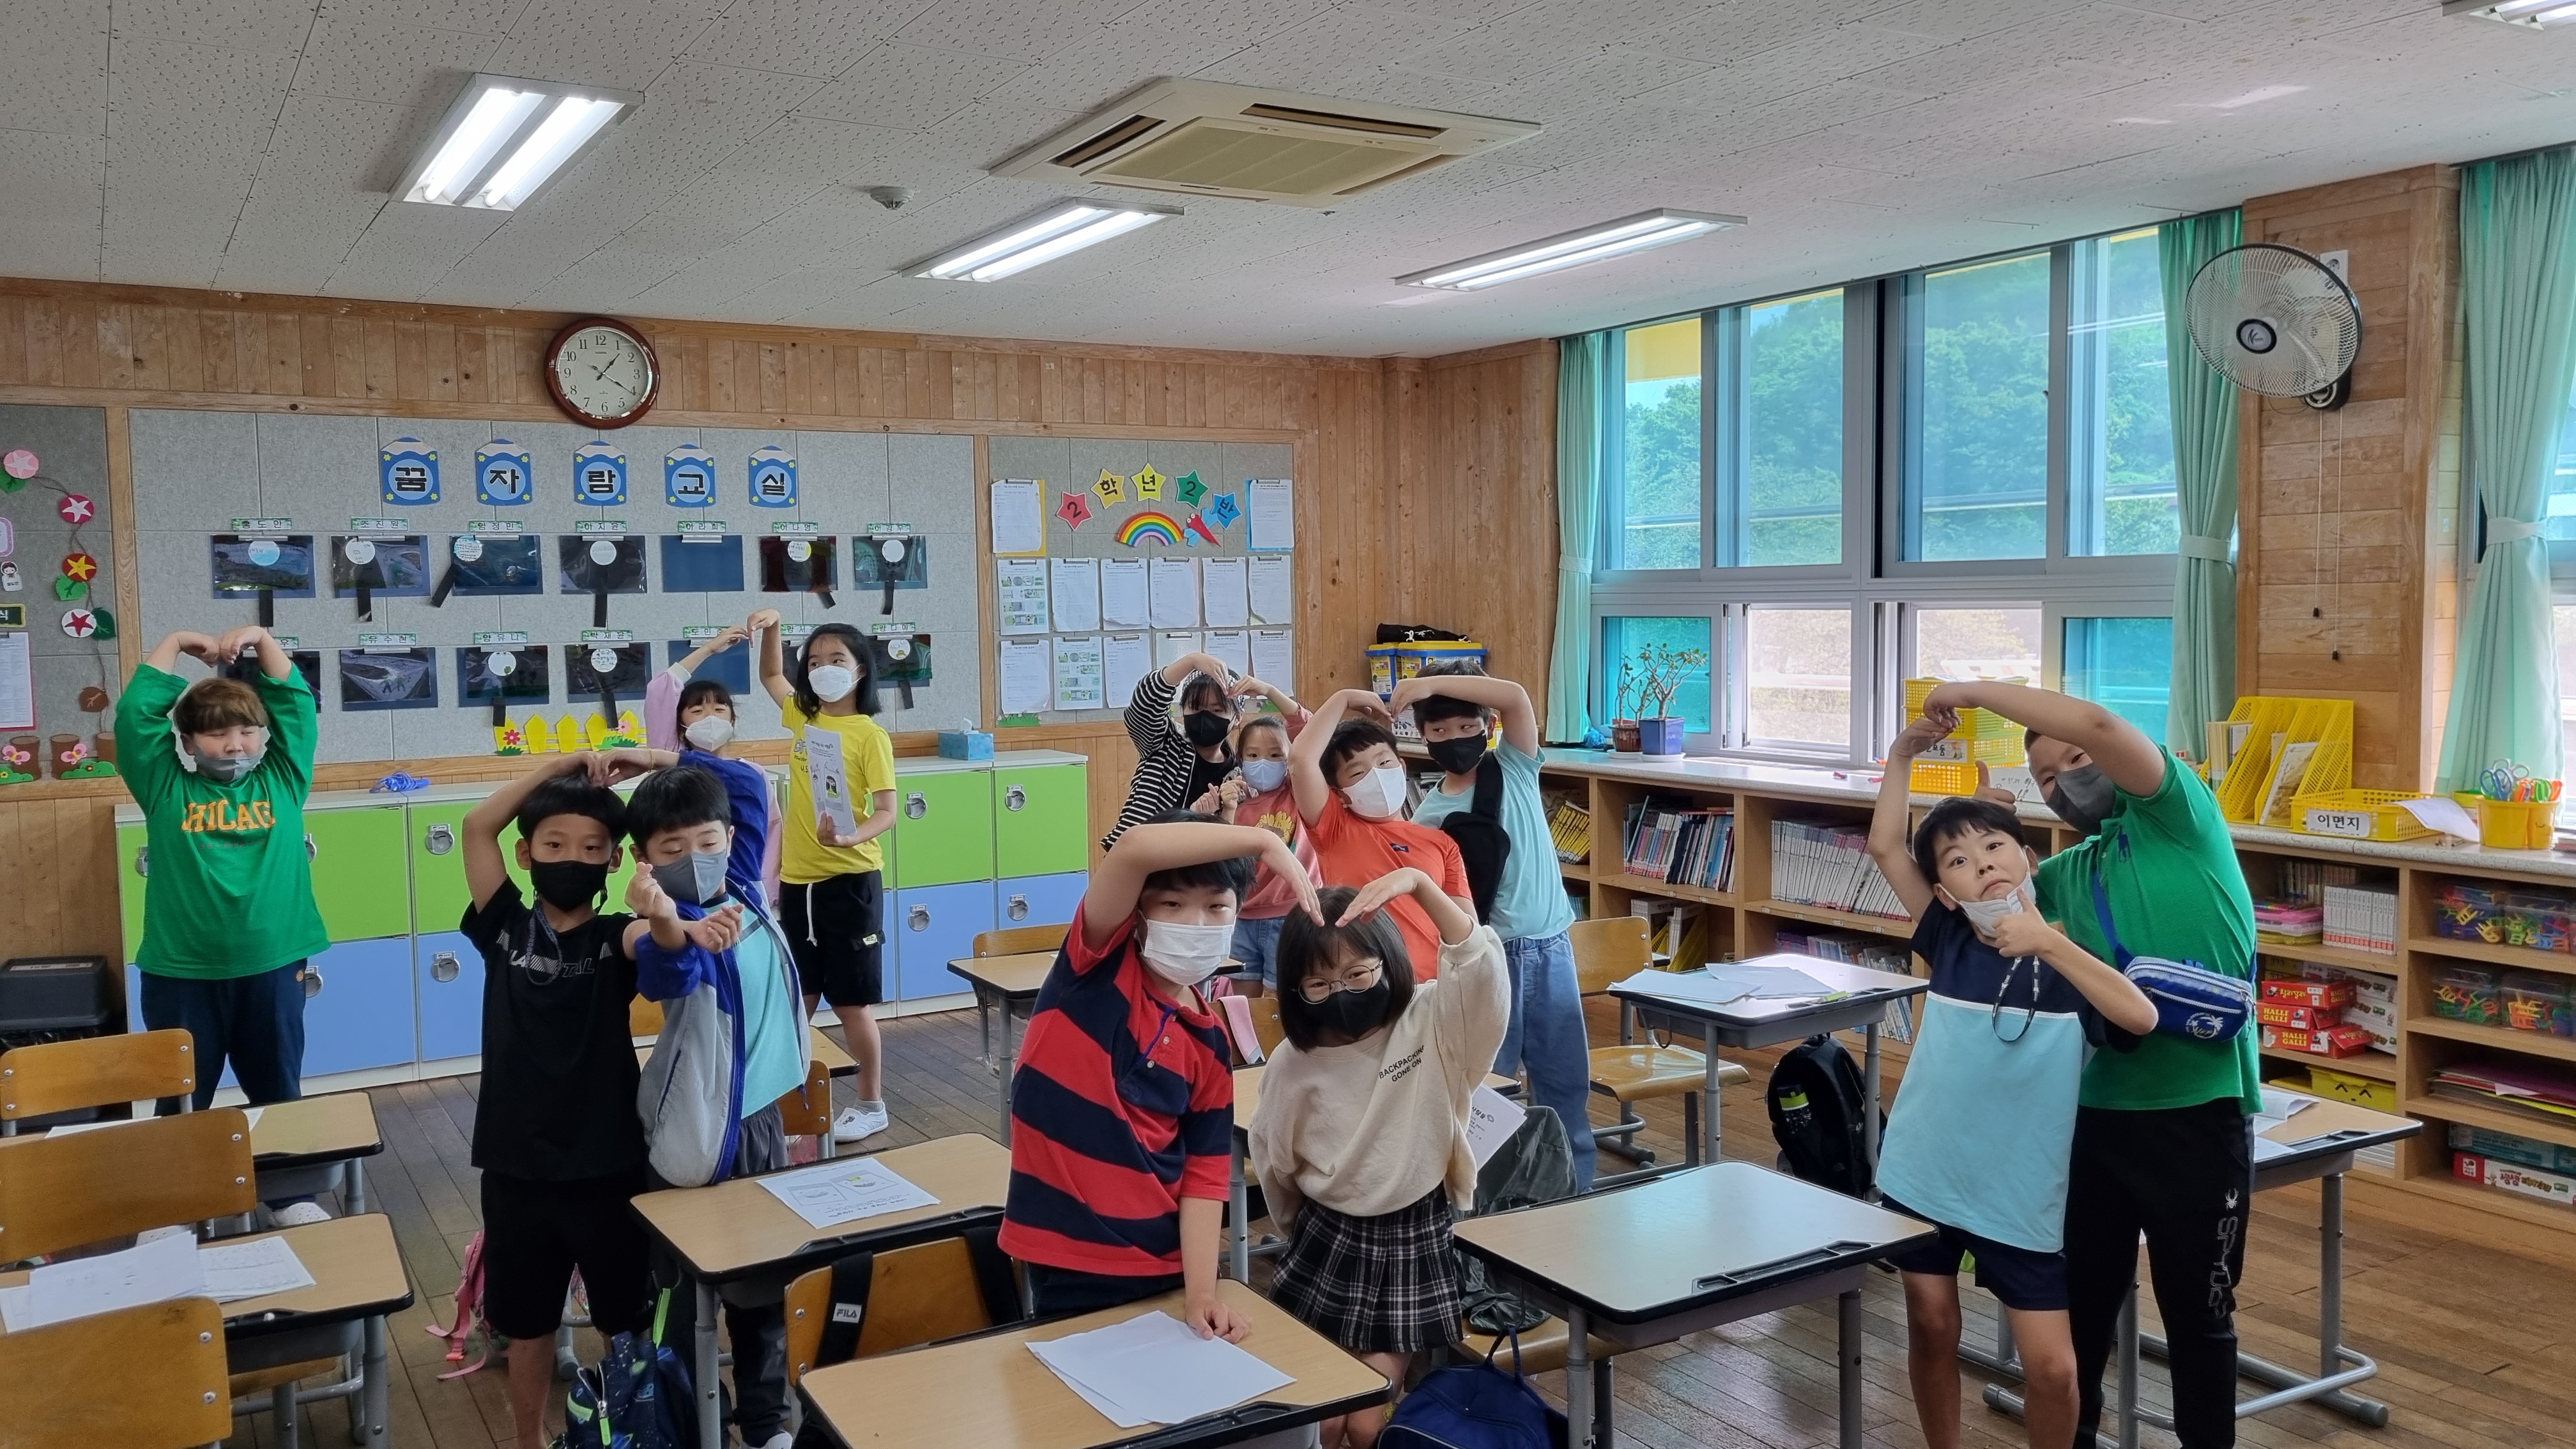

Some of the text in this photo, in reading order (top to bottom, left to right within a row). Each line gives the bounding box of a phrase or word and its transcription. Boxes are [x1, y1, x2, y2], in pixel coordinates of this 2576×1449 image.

[579, 339, 587, 349] 11
[595, 335, 606, 346] 12
[566, 351, 576, 362] 10
[627, 352, 634, 363] 2
[564, 367, 571, 378] 9
[633, 369, 640, 379] 3
[570, 385, 577, 395] 8
[630, 385, 637, 396] 4
[583, 397, 590, 408] 7
[601, 401, 608, 412] 6
[618, 397, 625, 408] 5
[395, 466, 785, 496] 꿈 자 람 교 실
[1067, 474, 1234, 519] 2 학 년 2 반
[181, 799, 276, 833] HICAG
[2317, 815, 2359, 831] 이면지
[2264, 1008, 2290, 1016] HALLI
[2264, 1015, 2288, 1023] GALLI
[2282, 1031, 2308, 1040] HALLI
[2282, 1038, 2307, 1046] GALLI
[1392, 1057, 1422, 1082] GONE ON
[836, 1308, 857, 1319] FILA
